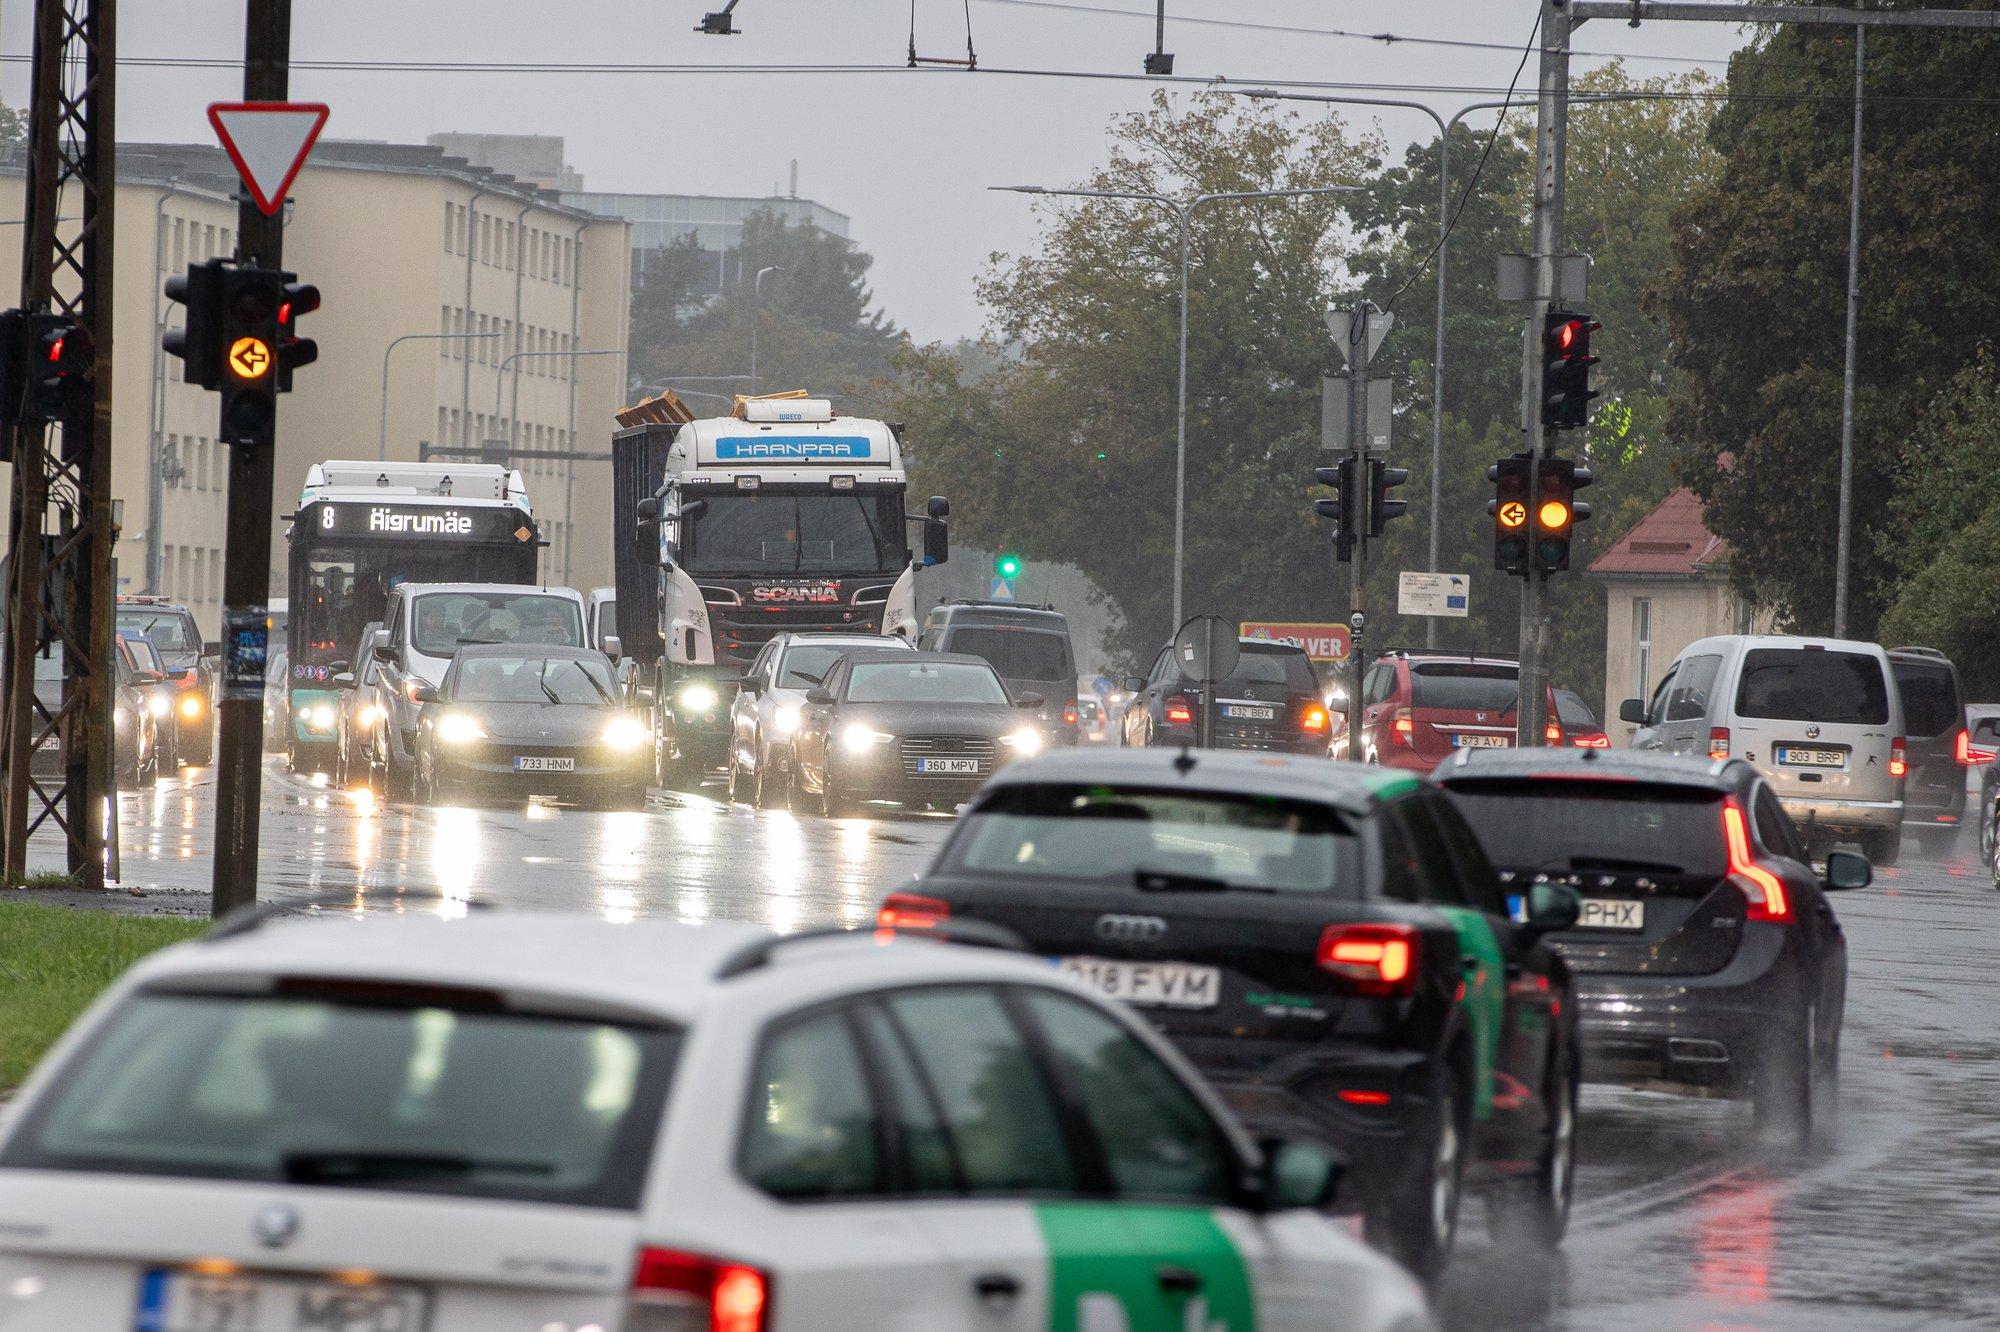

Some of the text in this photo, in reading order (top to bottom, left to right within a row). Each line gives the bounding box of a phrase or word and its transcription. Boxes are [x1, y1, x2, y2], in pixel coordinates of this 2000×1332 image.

[736, 443, 850, 456] HAANPAA
[322, 506, 472, 534] 8 Äigrumäe
[753, 587, 839, 602] SCANIA
[1231, 707, 1247, 716] 632
[1461, 736, 1504, 748] 873 AYJ
[522, 758, 571, 769] 733 HNM
[1790, 751, 1840, 764] 903 BRP
[927, 760, 975, 771] 360 MPV
[1585, 903, 1636, 924] PHX
[1131, 968, 1210, 999] FVM
